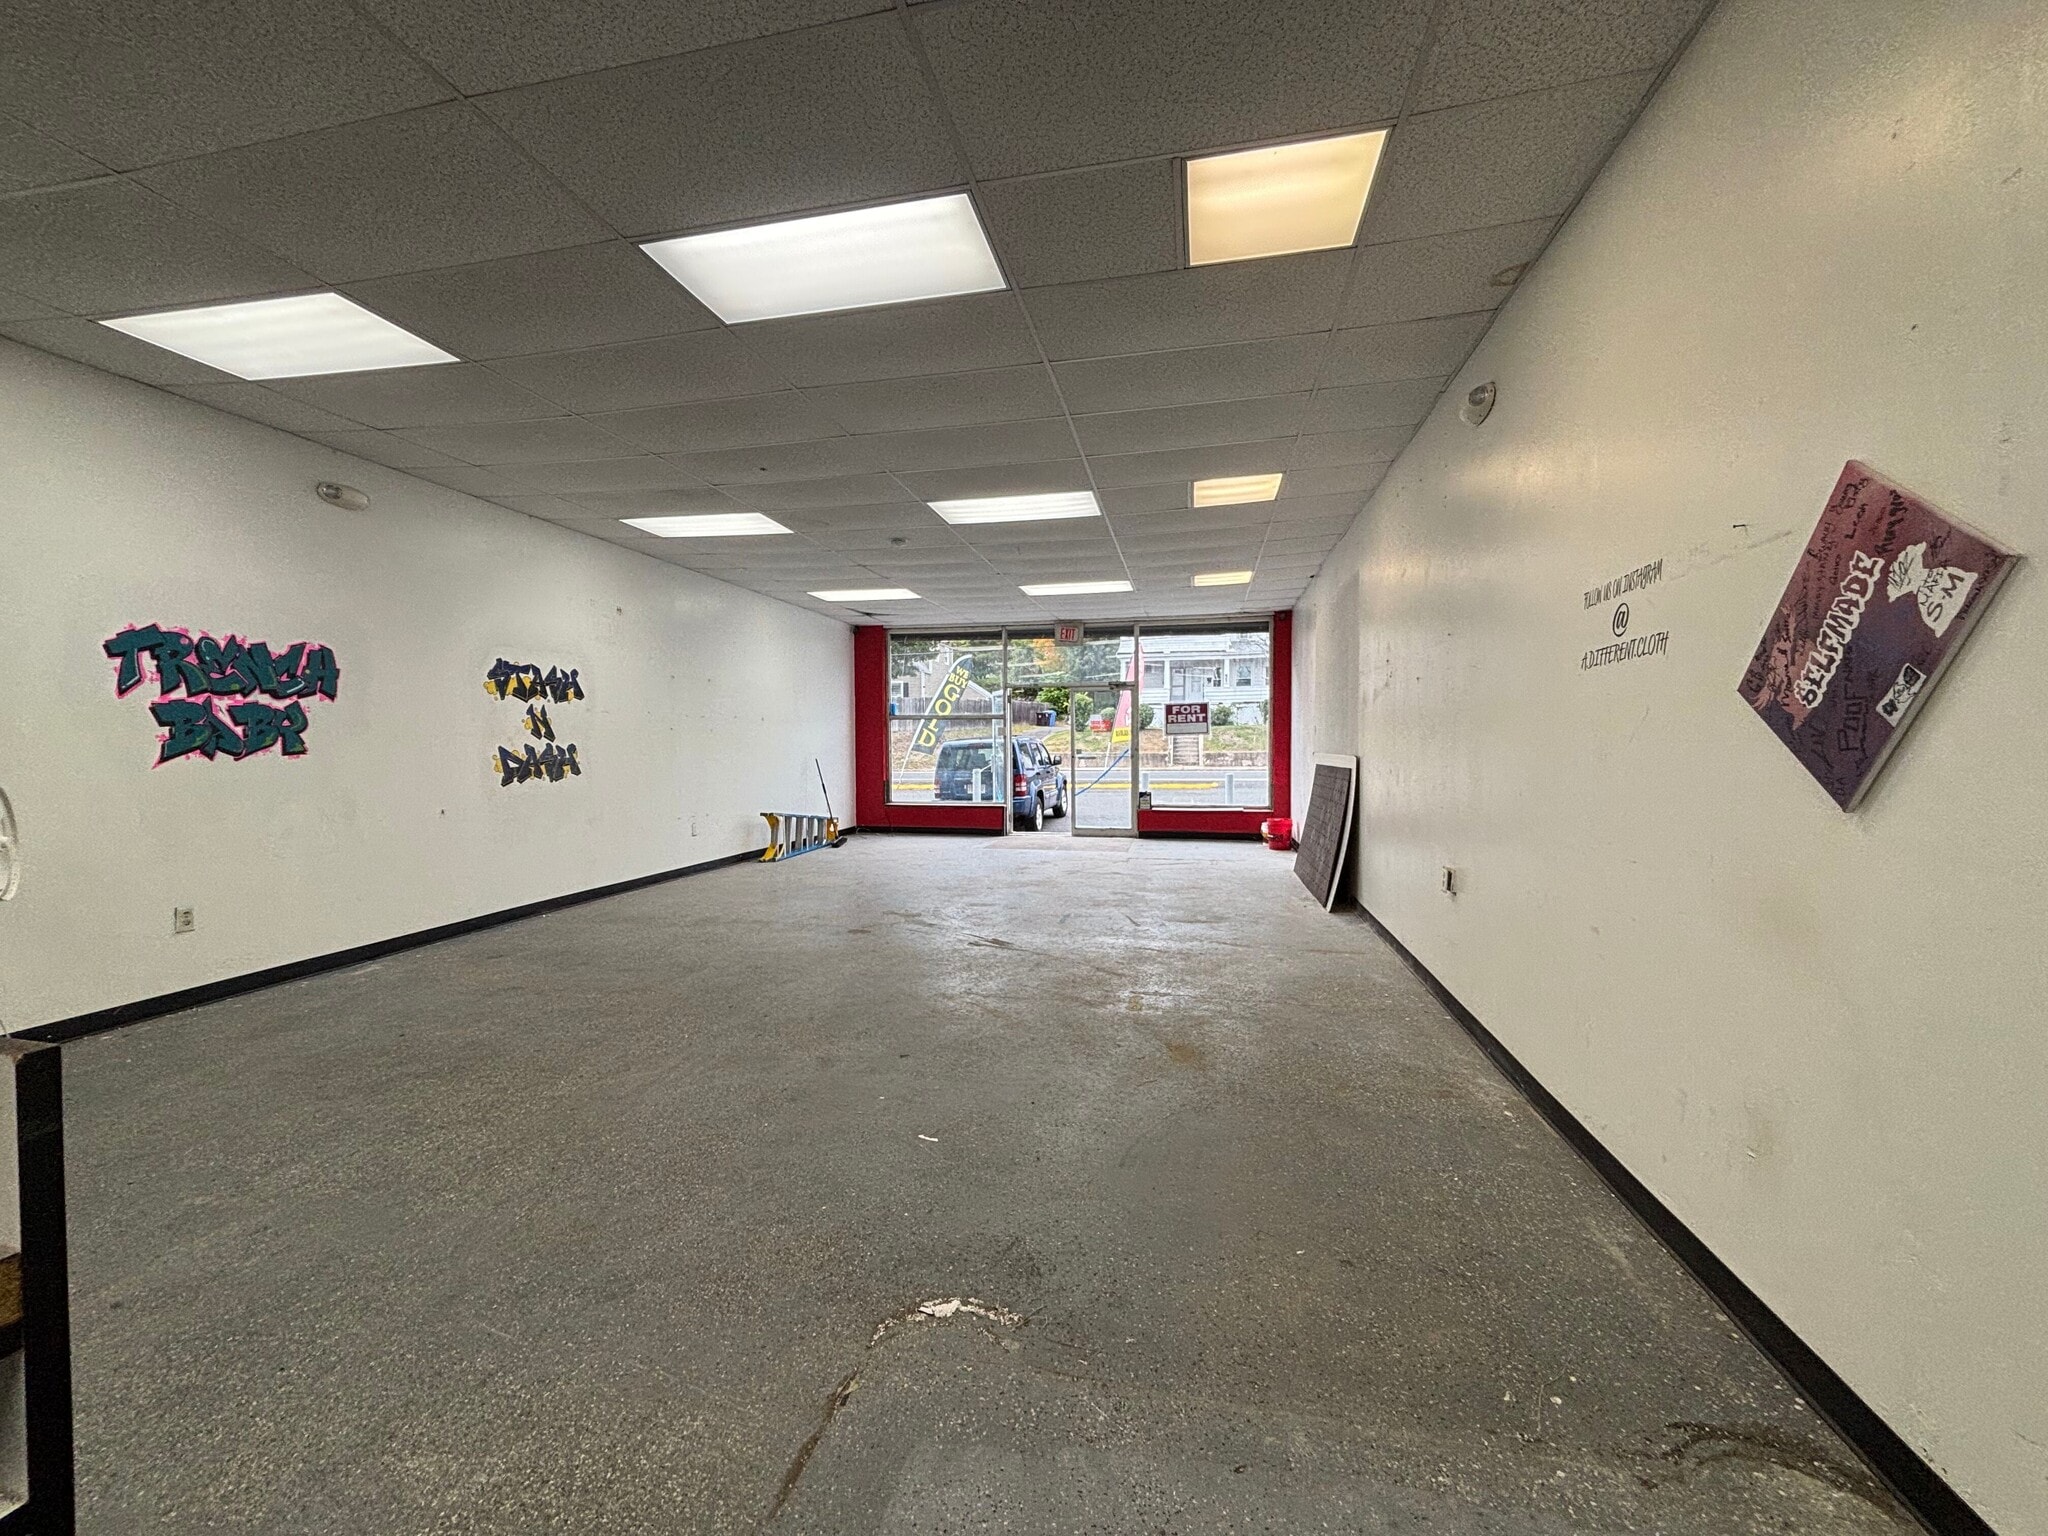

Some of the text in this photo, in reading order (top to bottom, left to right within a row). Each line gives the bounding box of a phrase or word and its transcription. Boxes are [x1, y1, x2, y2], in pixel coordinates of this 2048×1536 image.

[1603, 581, 1612, 601] US
[1612, 575, 1622, 599] ON
[1622, 558, 1663, 594] INSTAGRAM
[1612, 602, 1630, 638] @
[1793, 550, 1886, 709] SELFMADE
[1060, 627, 1076, 640] EXIT
[948, 672, 968, 689] BUY
[956, 665, 970, 679] WE
[918, 683, 961, 747] GOLD
[1168, 713, 1206, 723] RENT
[1172, 705, 1201, 714] FOR
[525, 703, 556, 743] N
